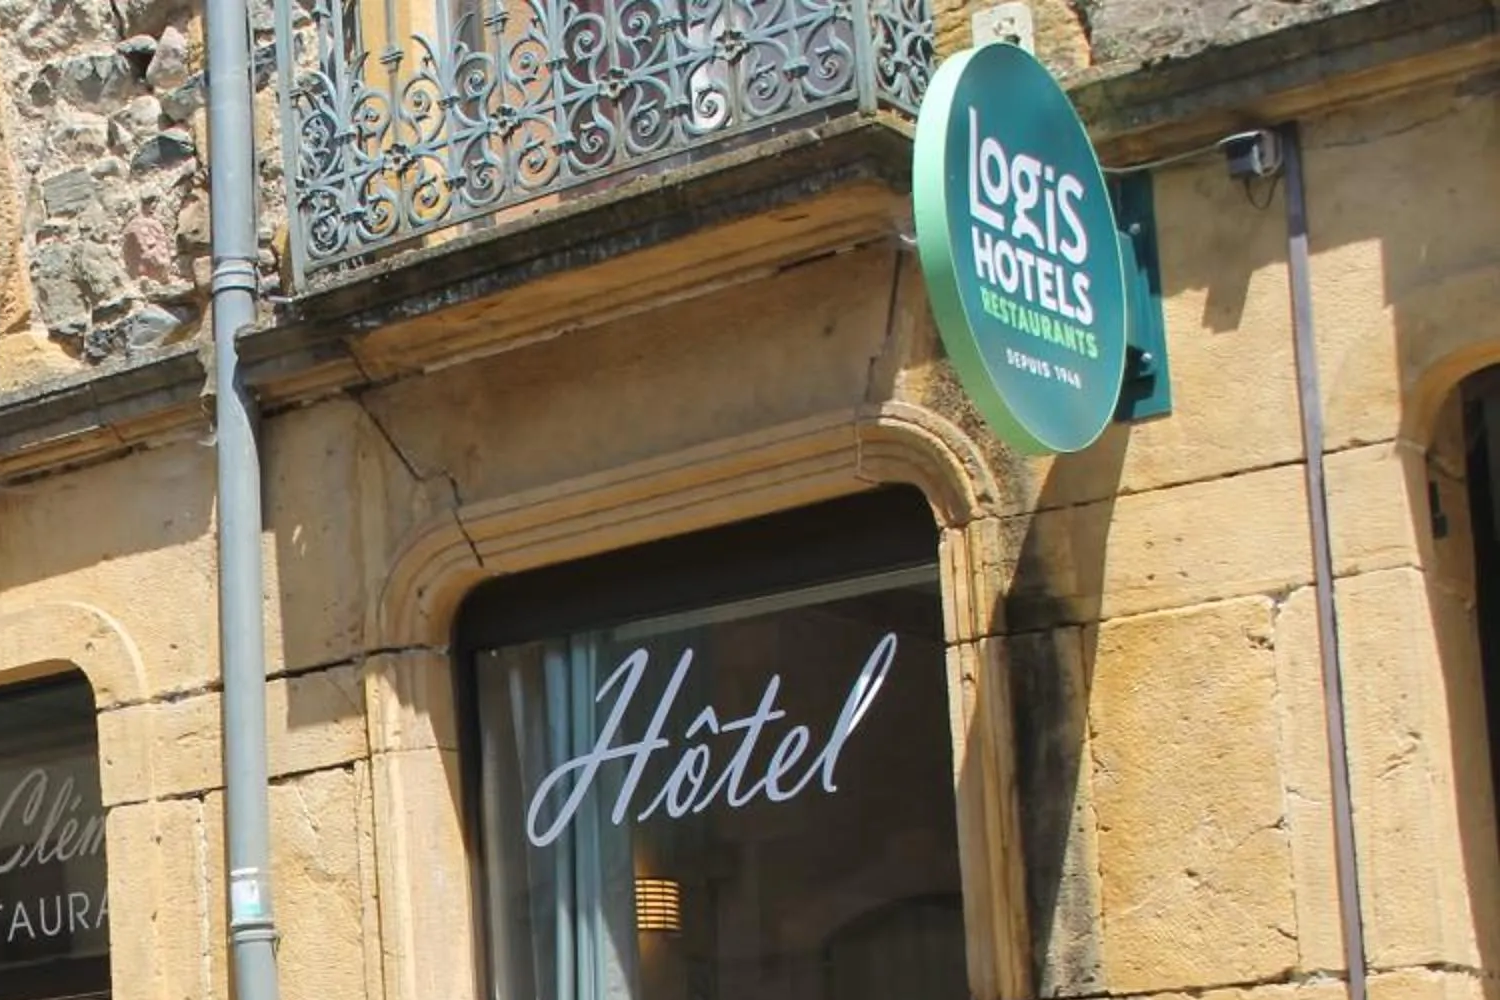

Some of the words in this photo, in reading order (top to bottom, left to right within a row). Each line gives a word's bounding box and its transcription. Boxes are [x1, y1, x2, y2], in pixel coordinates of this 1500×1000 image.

[971, 226, 1094, 325] HOTELS
[980, 286, 1098, 358] RESTAURANTS
[1006, 347, 1051, 379] DEPUIS
[527, 631, 898, 847] Hôtel
